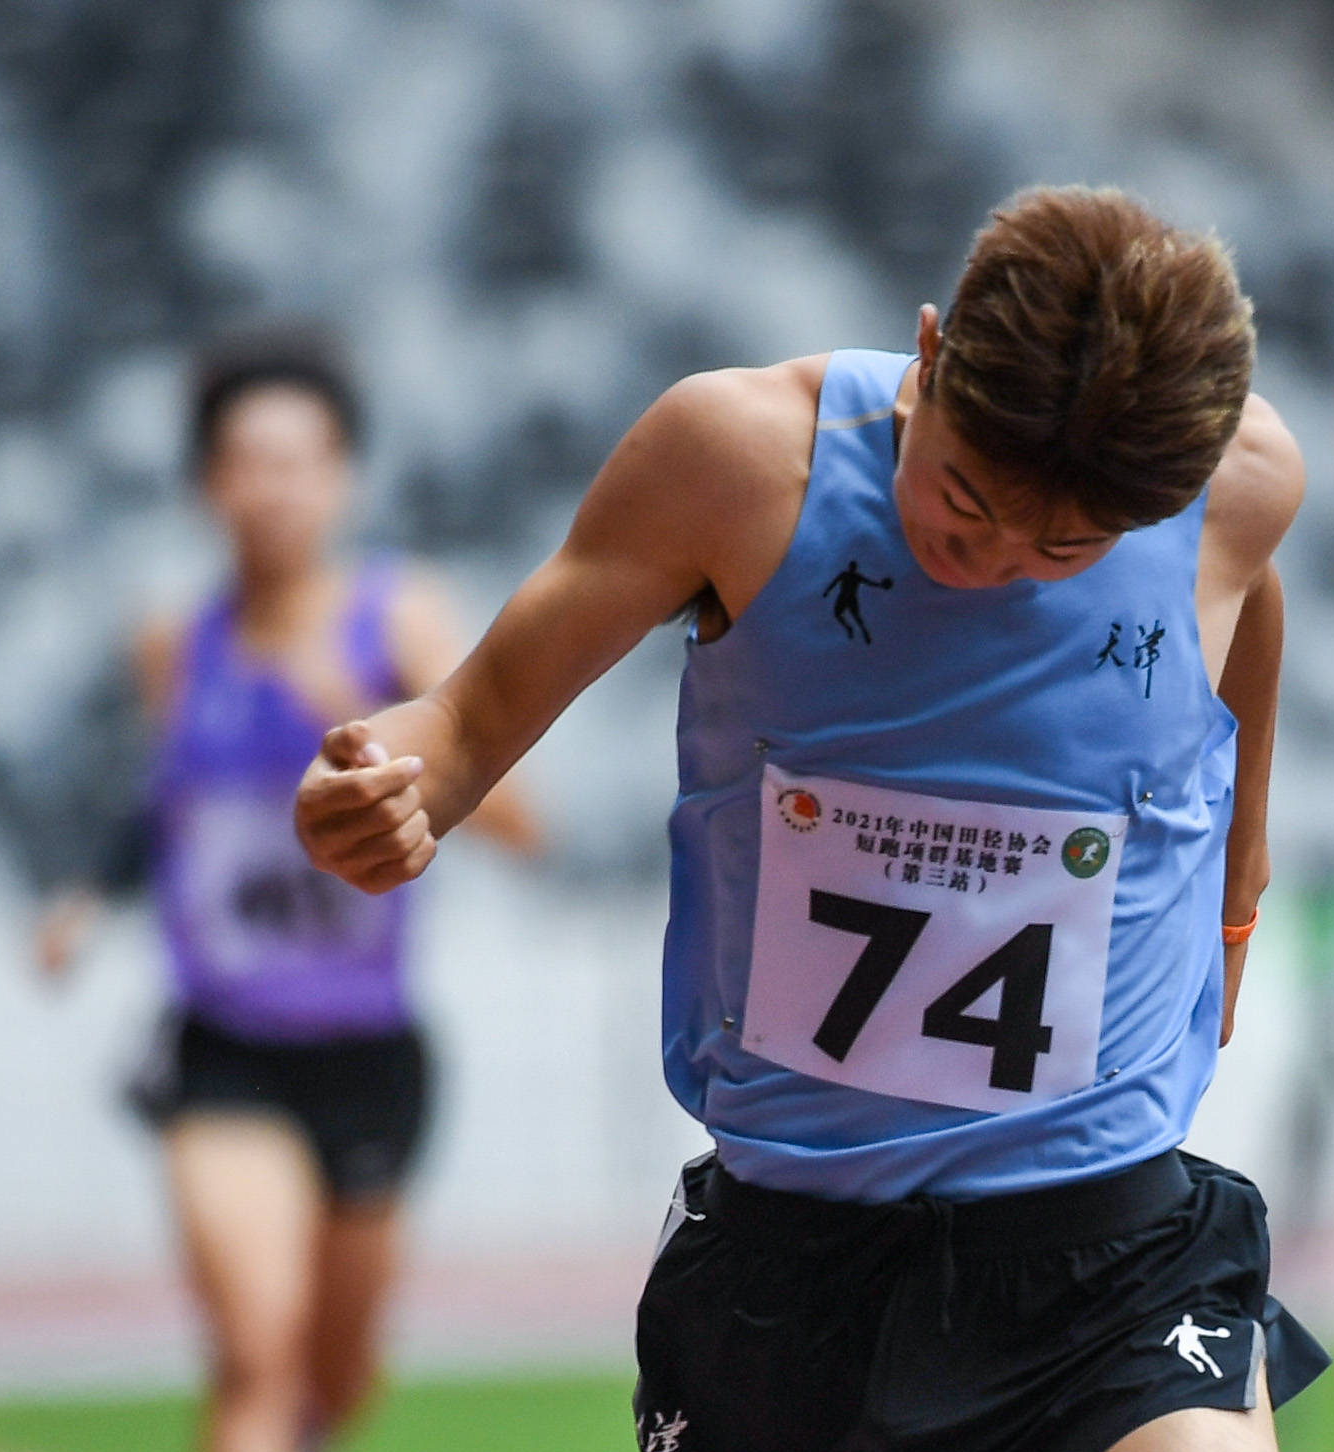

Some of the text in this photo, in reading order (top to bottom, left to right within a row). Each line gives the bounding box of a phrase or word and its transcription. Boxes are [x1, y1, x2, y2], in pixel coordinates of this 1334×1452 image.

[1091, 619, 1166, 699] 天津
[832, 807, 1053, 857] 2021年中国田径协会
[855, 833, 1024, 877] 短跑项群基地赛
[808, 888, 1054, 1093] 74
